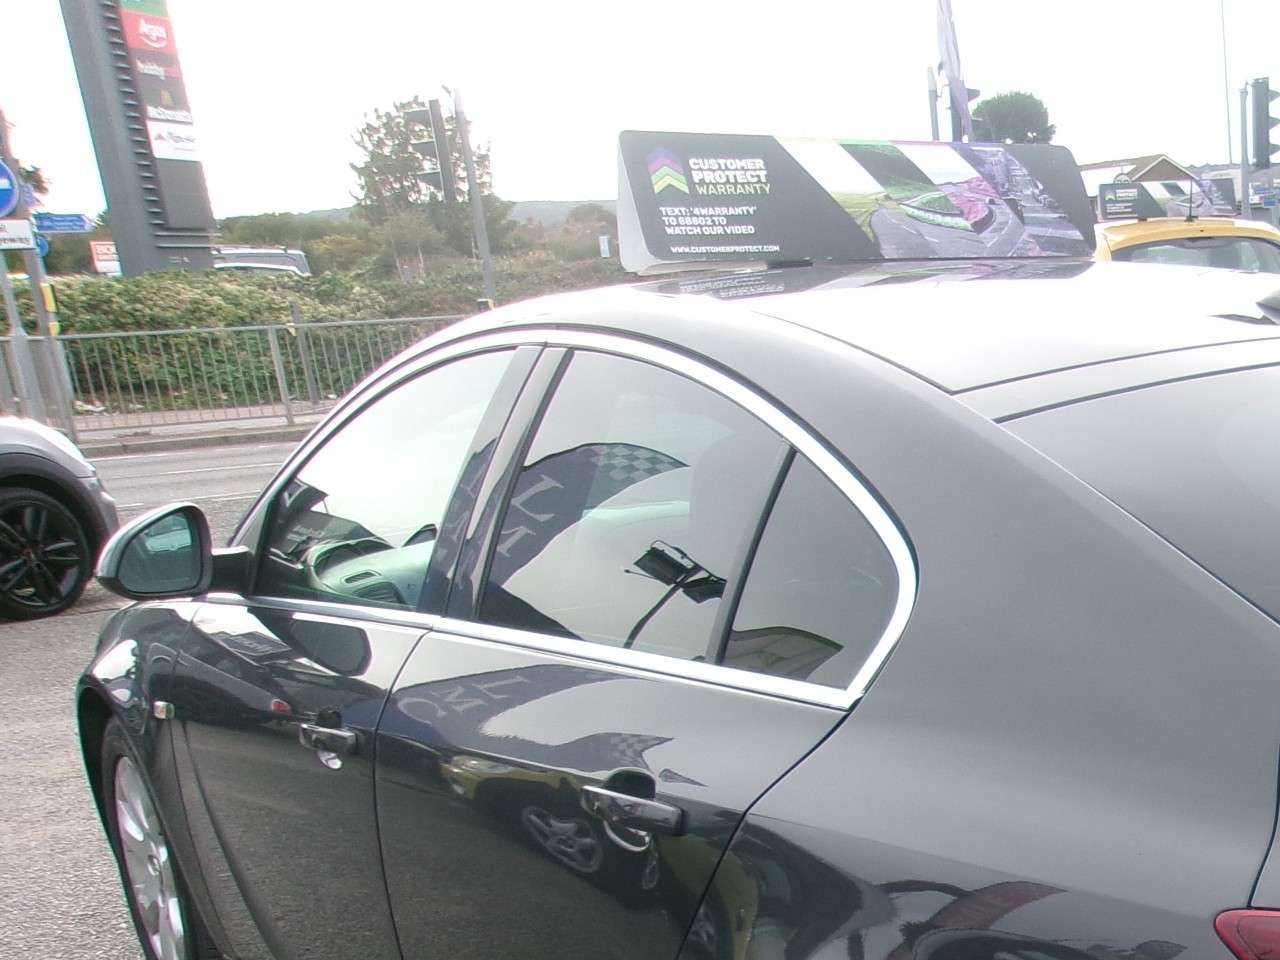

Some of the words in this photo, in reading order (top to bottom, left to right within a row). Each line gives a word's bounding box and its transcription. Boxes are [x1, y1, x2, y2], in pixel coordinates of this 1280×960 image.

[688, 158, 765, 170] CUSTOMER
[691, 170, 768, 184] PROTECT
[695, 183, 771, 195] WARRANTY
[659, 206, 690, 216] TEXT:
[662, 217, 677, 226] TO
[712, 216, 728, 225] TO
[664, 226, 701, 235] WATCH
[702, 226, 726, 235] OUR
[725, 225, 755, 235] VIDEO
